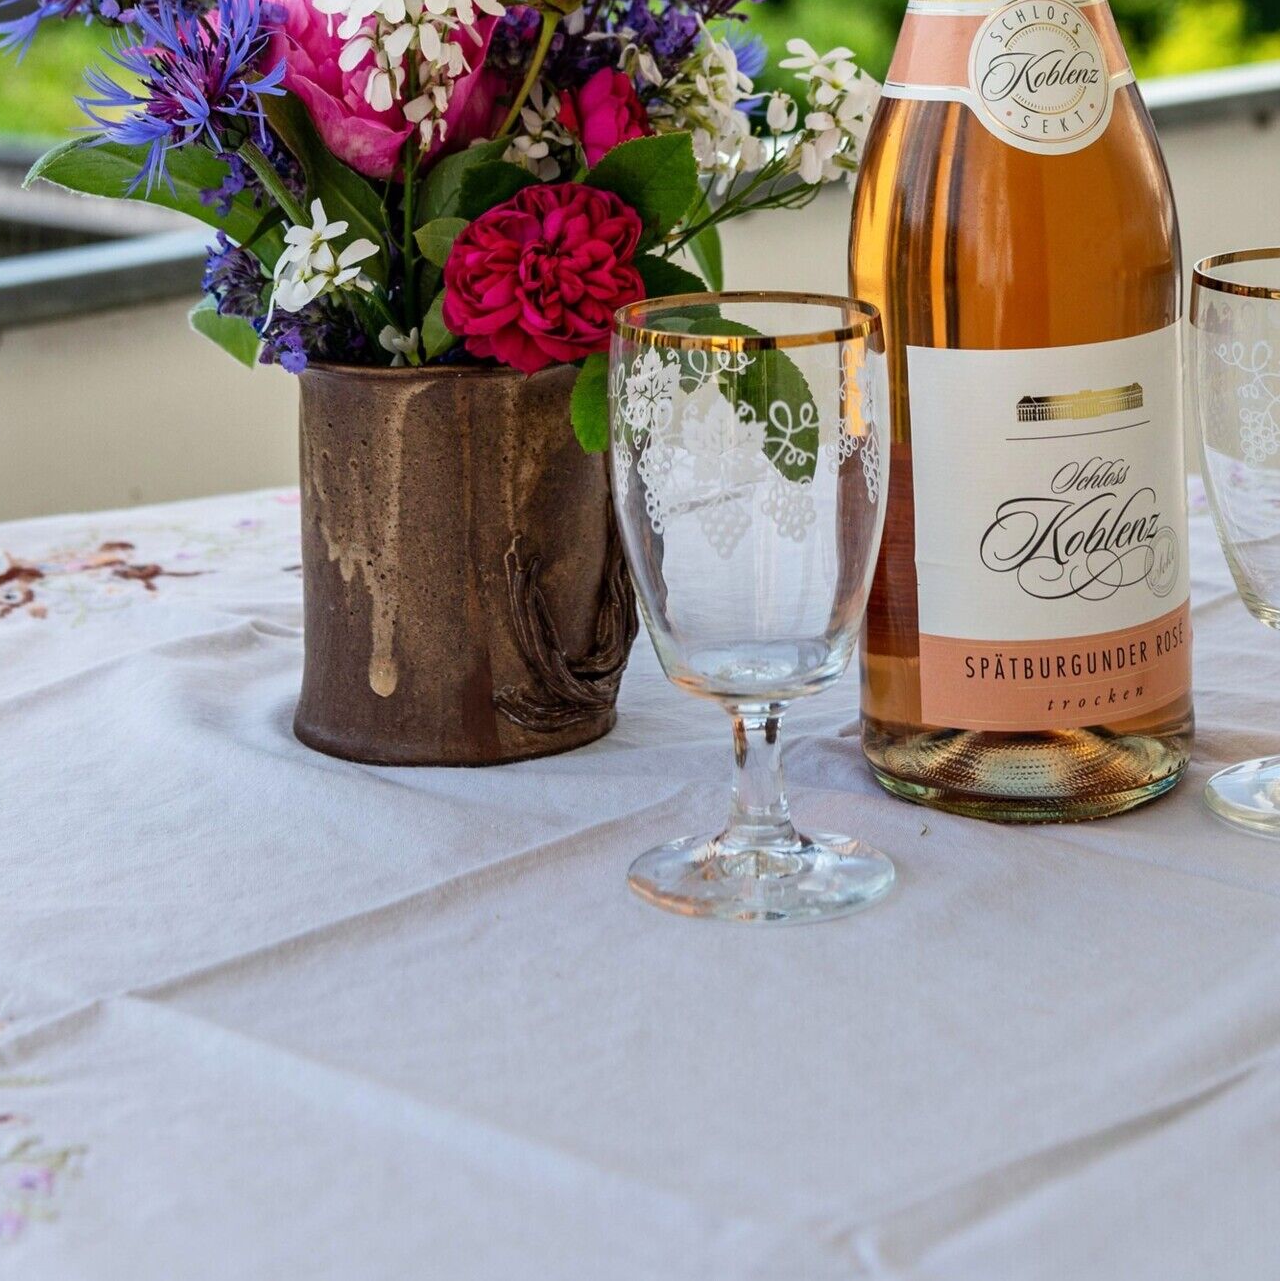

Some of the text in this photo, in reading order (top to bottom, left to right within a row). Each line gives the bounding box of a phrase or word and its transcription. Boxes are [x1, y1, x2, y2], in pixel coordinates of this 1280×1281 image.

[990, 5, 1082, 42] SCHLOSS
[981, 49, 1100, 101] Koblenz
[1022, 110, 1084, 133] SEKT
[1051, 457, 1130, 494] Schloss
[980, 487, 1160, 601] Koblenz
[965, 618, 1183, 680] SPÄTBURGUNDER ROSÉ
[1047, 685, 1144, 711] trocken
